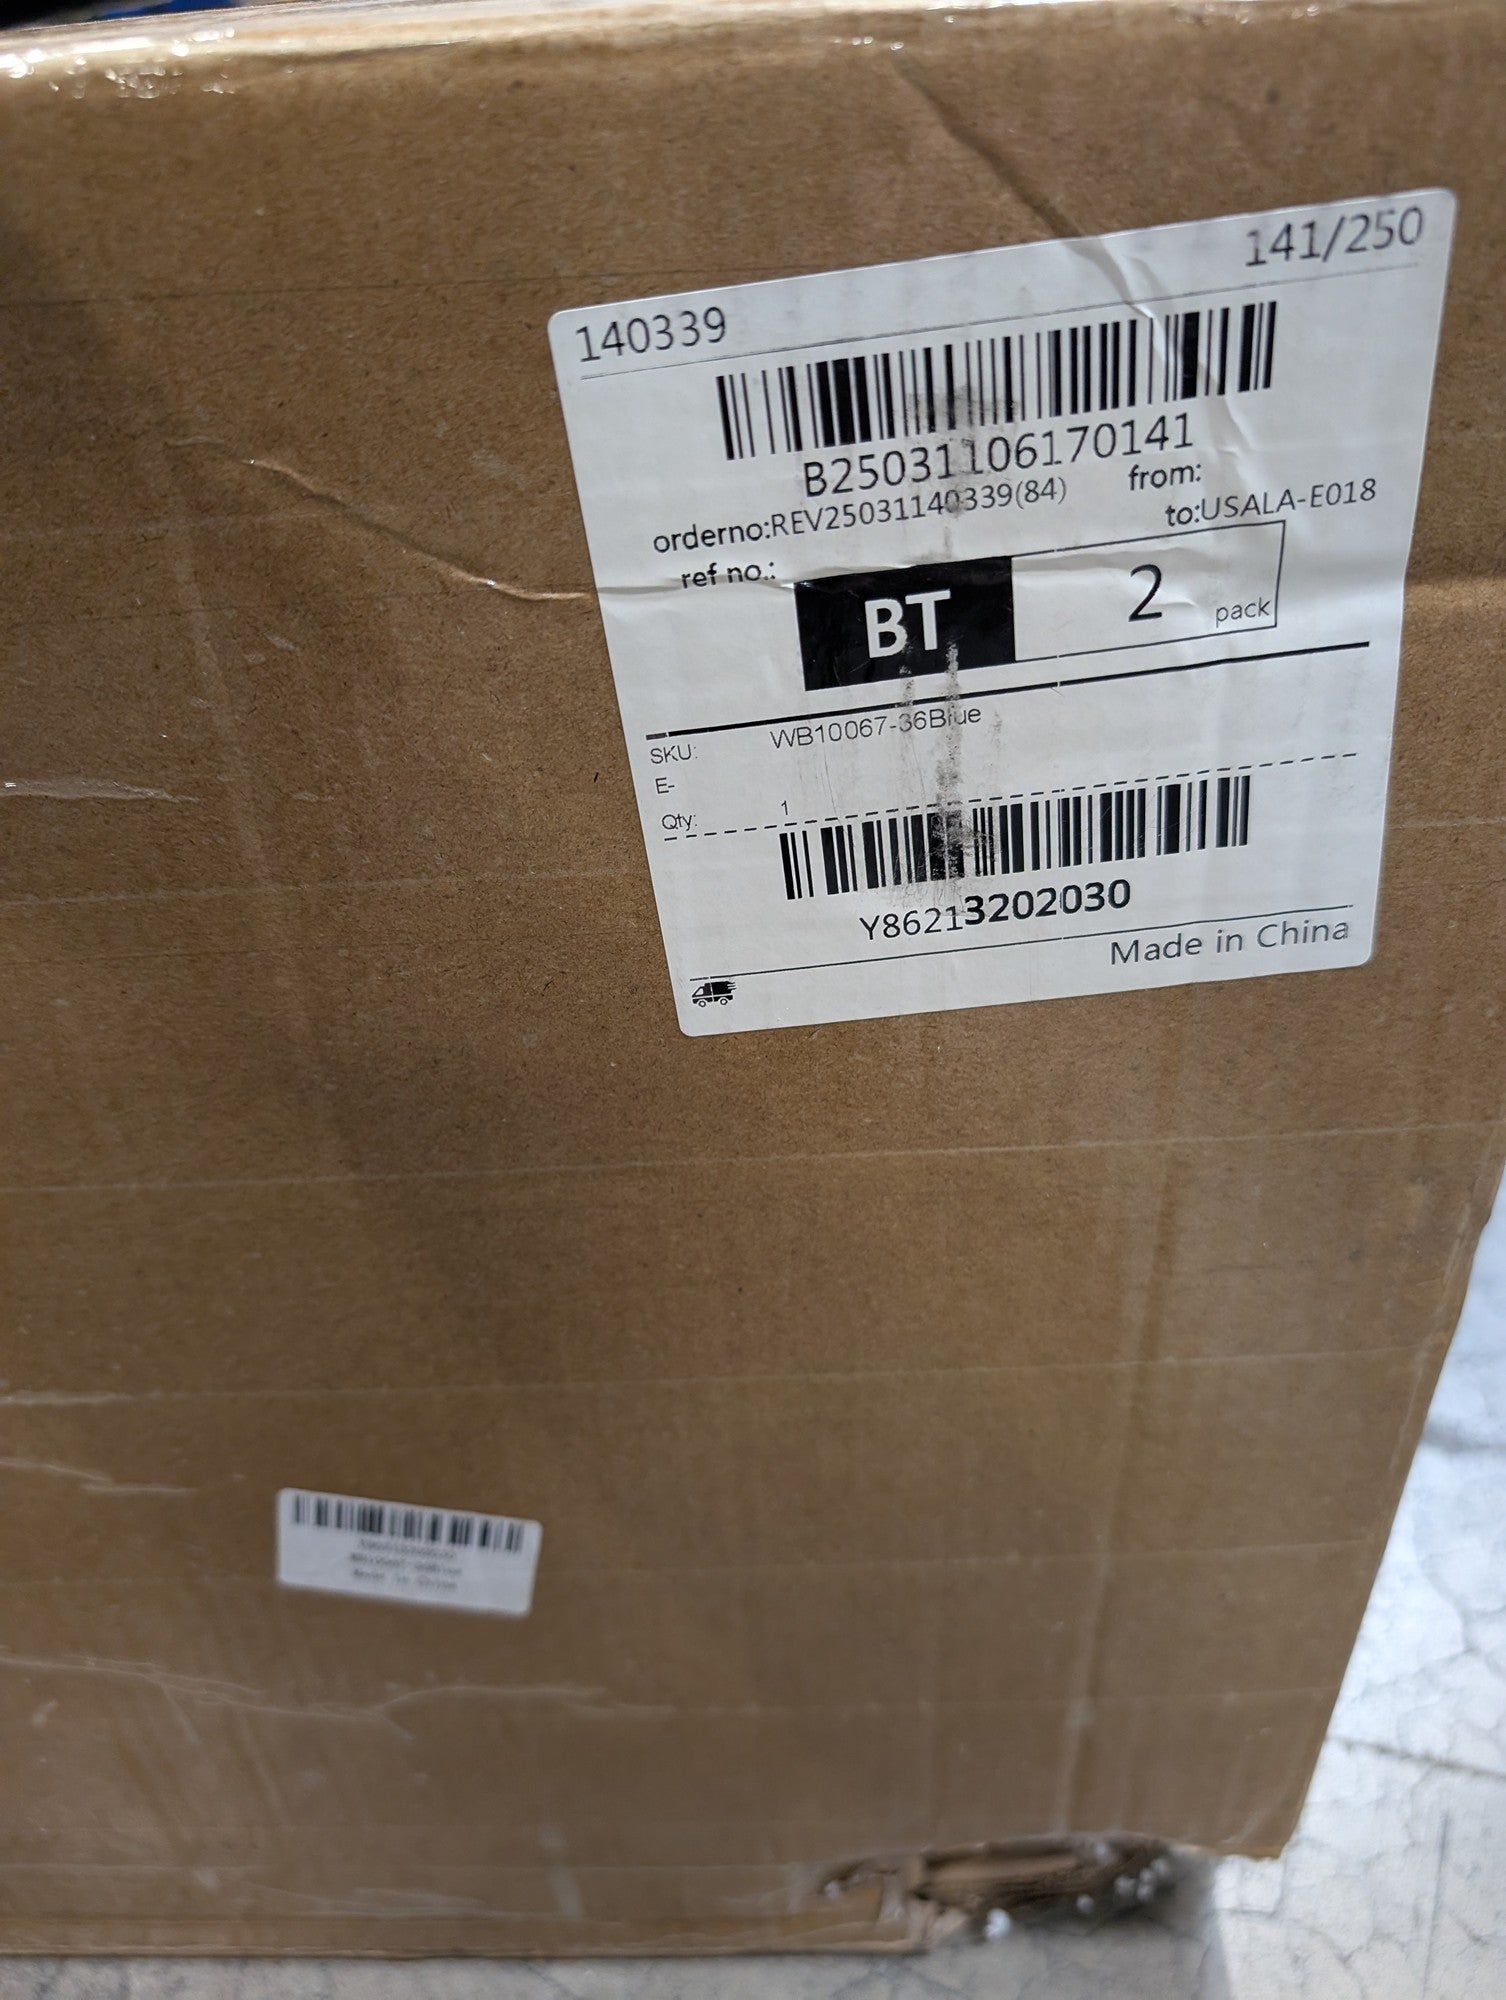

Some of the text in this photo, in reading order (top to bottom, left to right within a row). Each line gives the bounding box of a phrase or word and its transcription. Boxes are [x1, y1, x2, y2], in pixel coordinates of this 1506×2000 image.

[1245, 207, 1425, 267] 141/250
[575, 306, 727, 362] 140339
[803, 412, 1194, 497] B25031106170141
[1129, 463, 1202, 491] from:
[1165, 478, 1377, 528] to:USALA-E018
[681, 560, 776, 590] ref no.:
[1128, 563, 1163, 622] 2
[864, 588, 951, 658] BT
[1215, 597, 1271, 628] pack
[770, 706, 982, 750] WB10067-36Blue
[650, 744, 699, 765] SKU:
[655, 777, 676, 795] E-
[781, 799, 790, 816] 1
[662, 811, 698, 831] Qty:
[859, 878, 1131, 941] Y86213202030
[1111, 920, 1350, 965] Made in China
